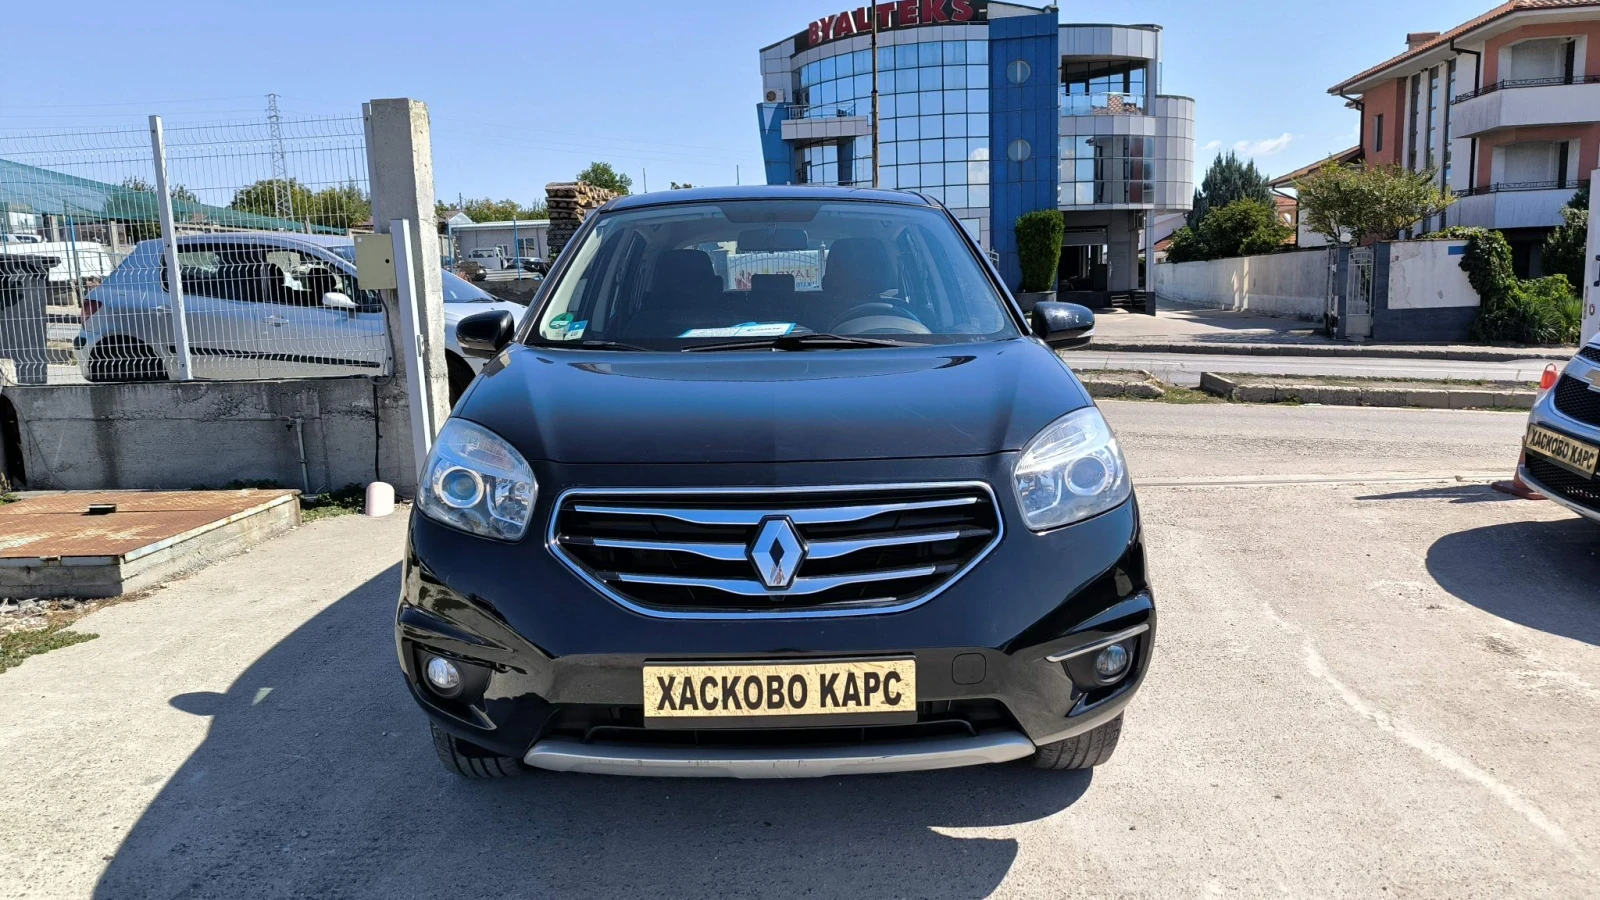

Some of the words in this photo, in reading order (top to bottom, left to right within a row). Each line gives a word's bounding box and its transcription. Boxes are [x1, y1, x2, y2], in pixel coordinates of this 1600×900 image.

[808, 0, 974, 46] BYALTEKS
[1530, 429, 1569, 459] ХАСКОВО
[1570, 445, 1595, 470] КАРС
[657, 674, 808, 711] ХАСКОВО
[819, 671, 903, 708] КАРС
